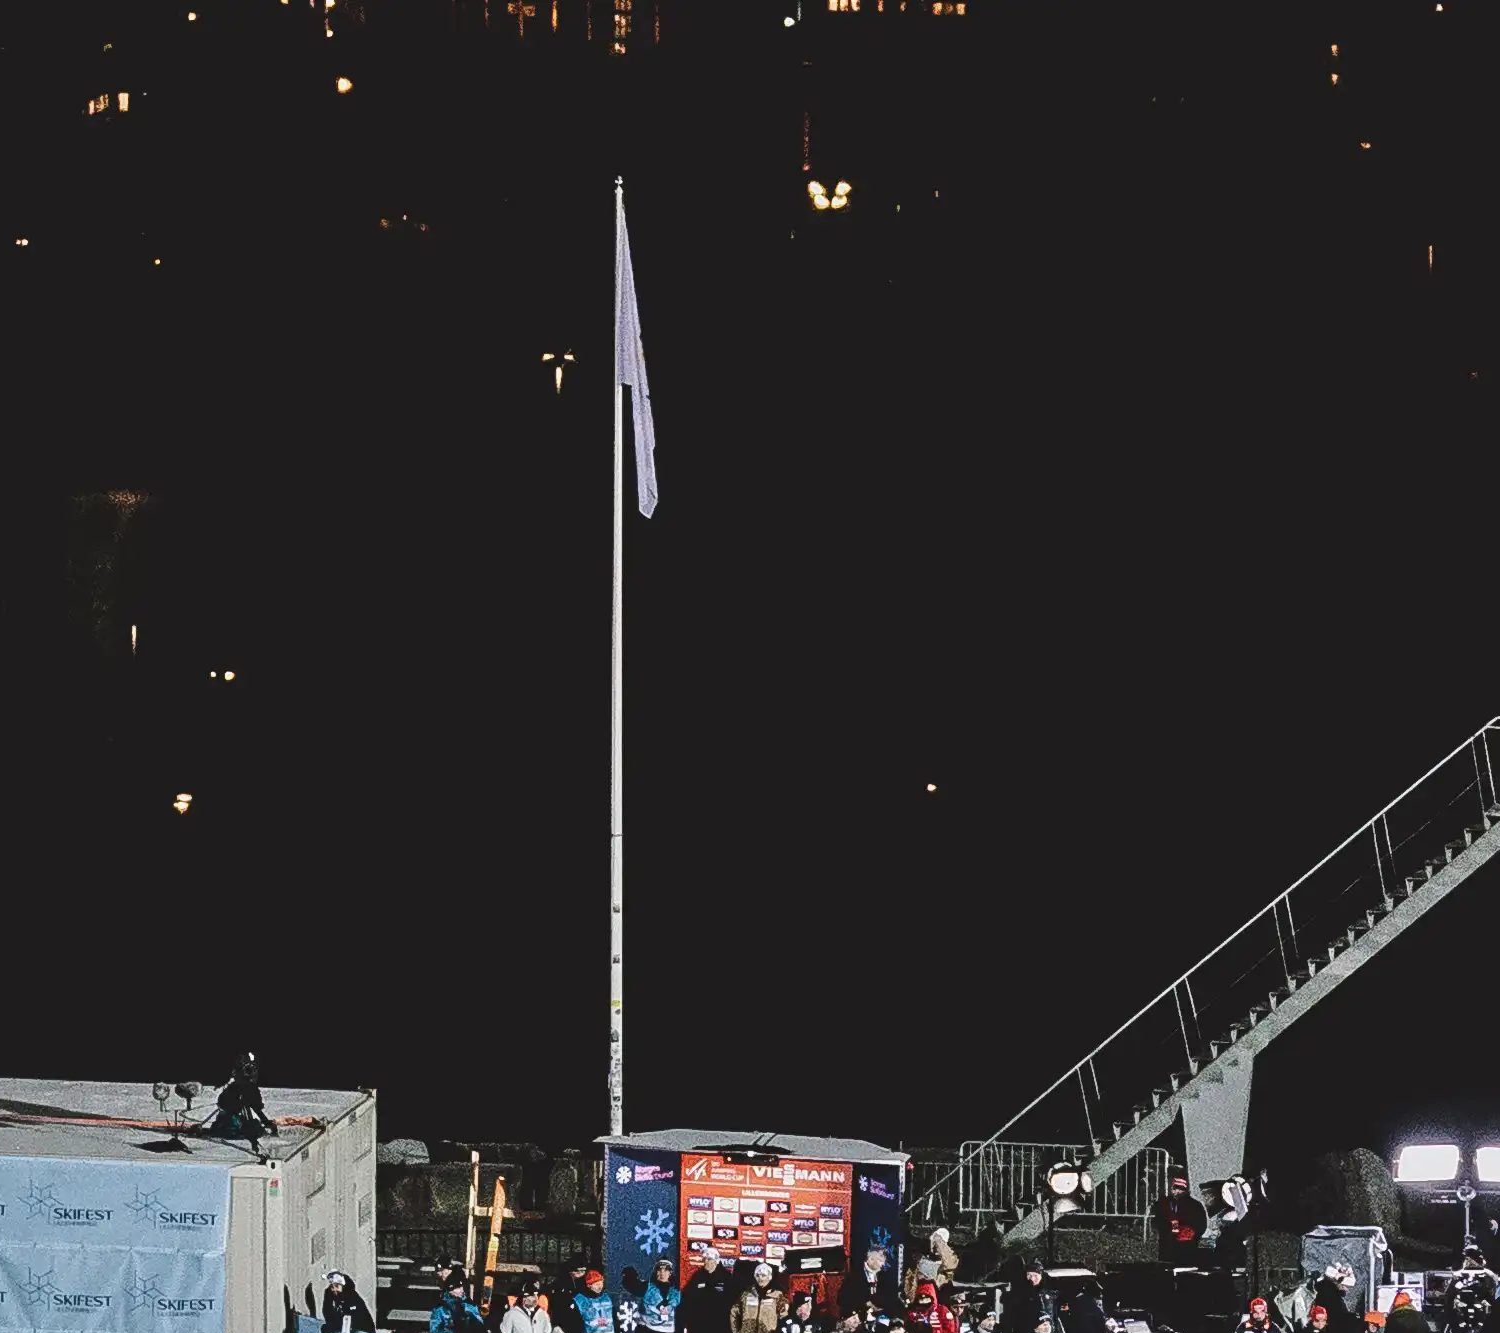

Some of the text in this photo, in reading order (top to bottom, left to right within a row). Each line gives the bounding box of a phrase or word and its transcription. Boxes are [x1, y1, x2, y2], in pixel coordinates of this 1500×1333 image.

[753, 1163, 845, 1186] VIESSMANN
[53, 1207, 113, 1221] SKIFEST
[159, 1212, 218, 1226] SKIFEST
[53, 1294, 112, 1307] SKIFEST
[157, 1299, 214, 1311] SKIFEST
